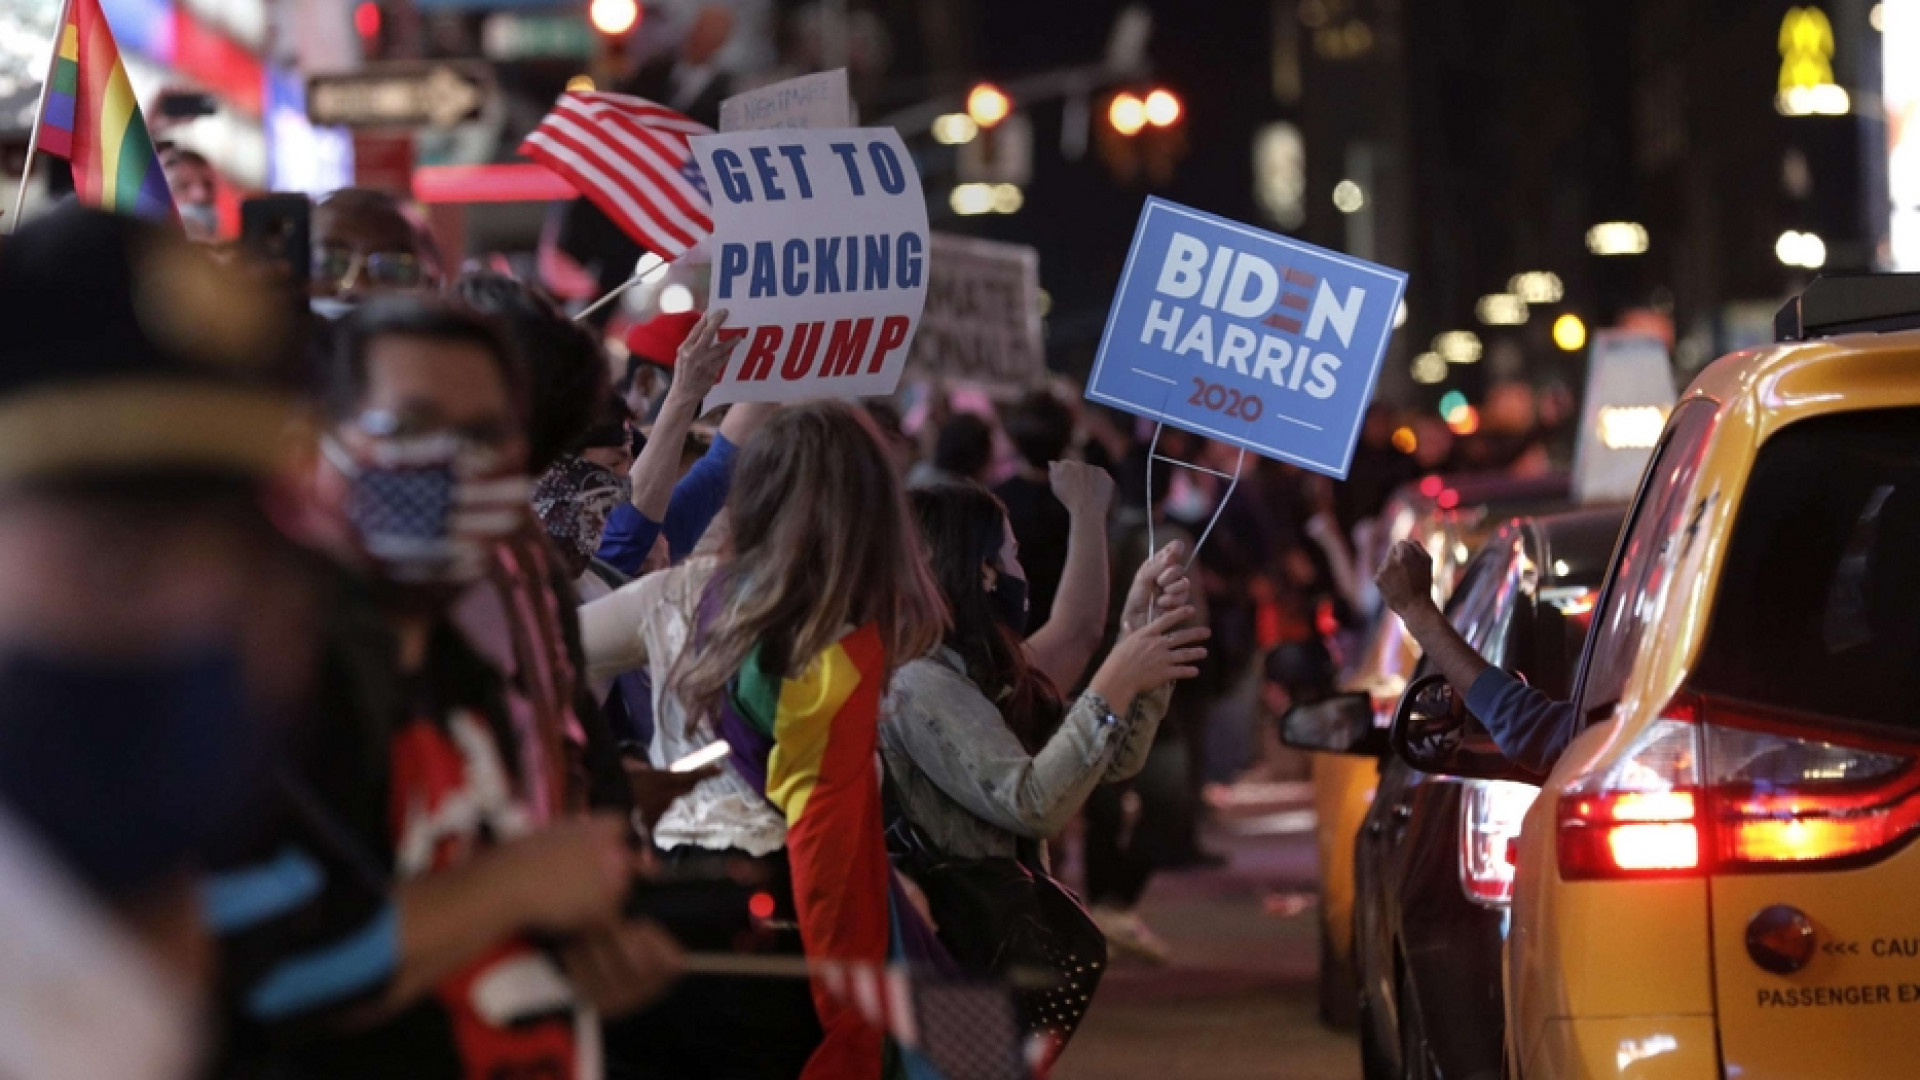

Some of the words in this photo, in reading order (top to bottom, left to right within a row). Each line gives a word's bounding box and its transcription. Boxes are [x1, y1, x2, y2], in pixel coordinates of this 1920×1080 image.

[711, 143, 814, 204] GET
[829, 140, 906, 196] TO
[717, 231, 923, 299] PACKING
[1156, 231, 1366, 349] BIDEN
[1140, 299, 1343, 400] HARRIS
[1187, 376, 1264, 423] 2020
[1757, 985, 1891, 1008] PASSENGER
